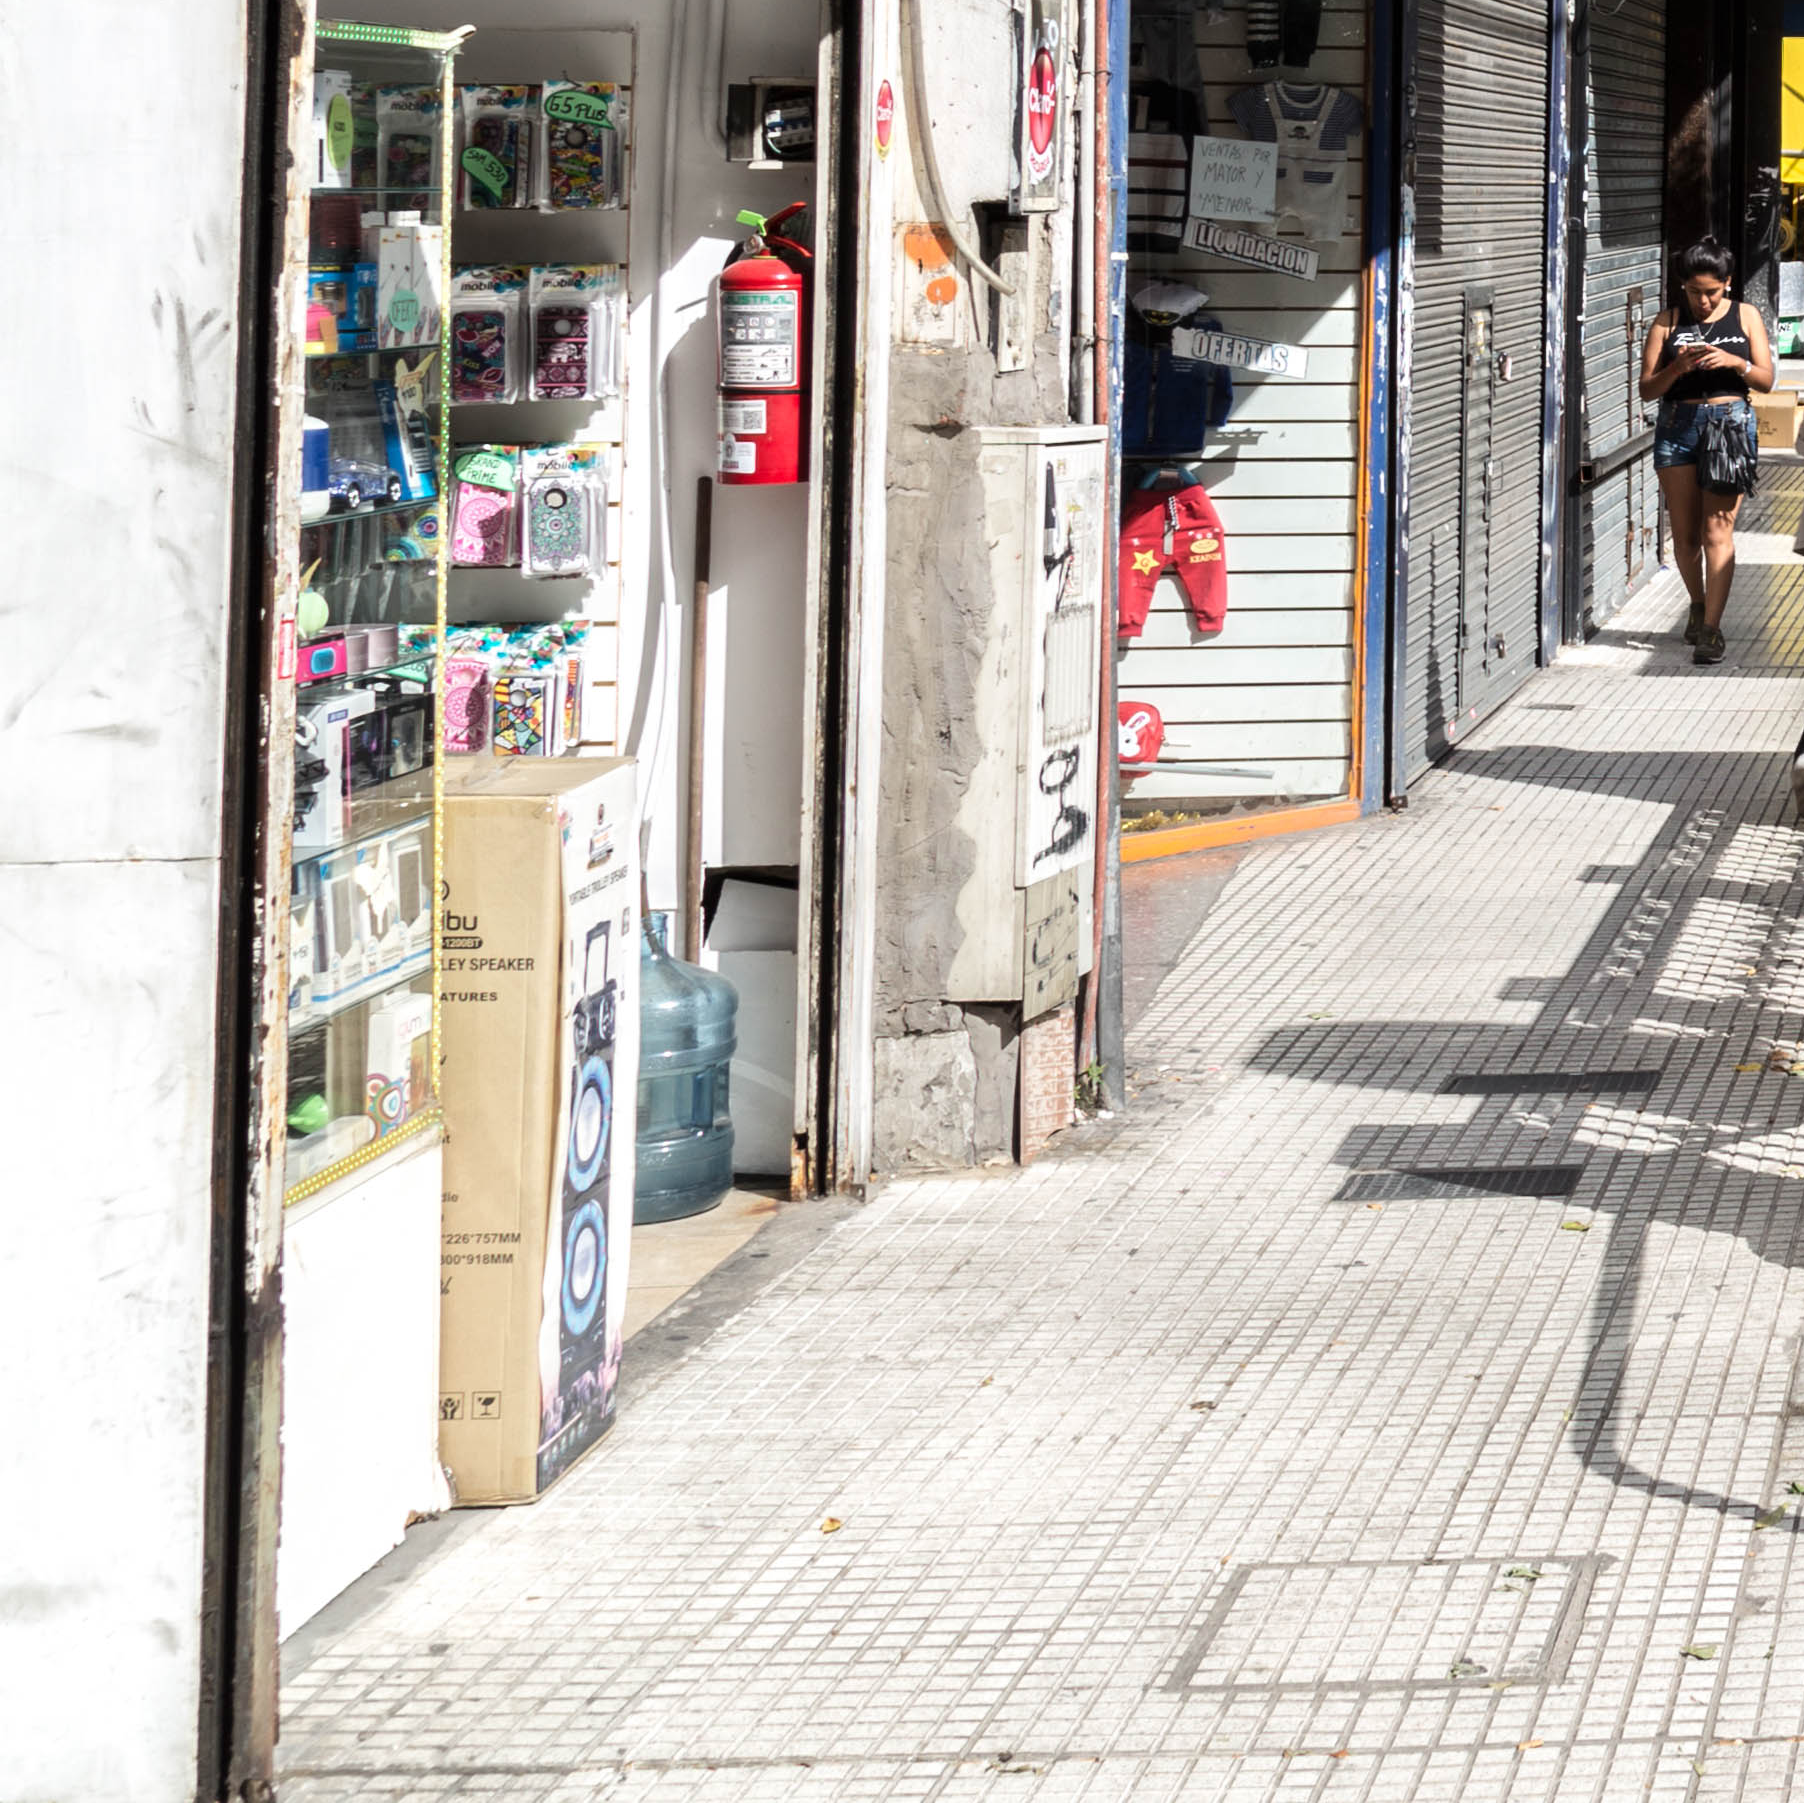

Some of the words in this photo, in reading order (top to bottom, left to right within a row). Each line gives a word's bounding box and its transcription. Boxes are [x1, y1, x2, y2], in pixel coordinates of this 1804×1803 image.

[1203, 161, 1247, 184] MAYOR
[1196, 220, 1309, 274] LIQUIDACION
[1191, 330, 1289, 374] OFERTAS
[469, 957, 535, 972] SPEAKER
[440, 991, 499, 1002] ATURES
